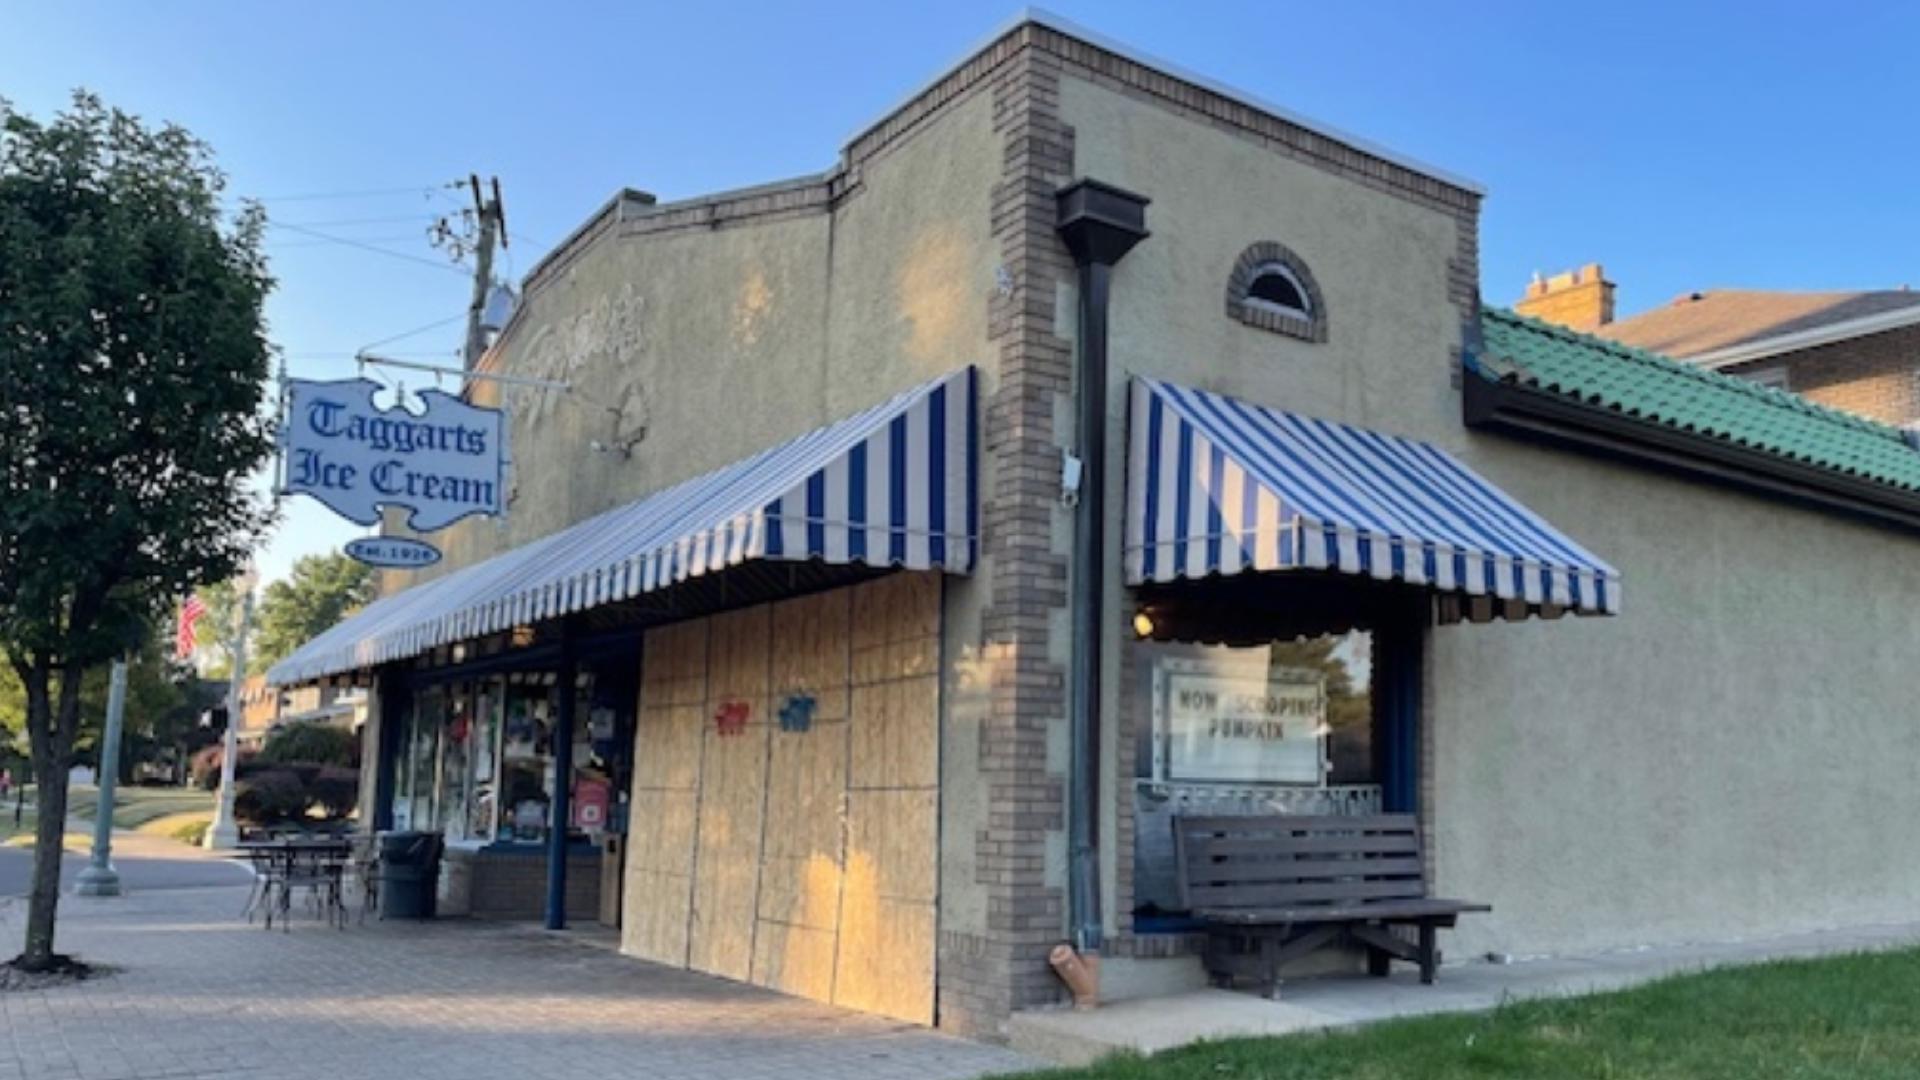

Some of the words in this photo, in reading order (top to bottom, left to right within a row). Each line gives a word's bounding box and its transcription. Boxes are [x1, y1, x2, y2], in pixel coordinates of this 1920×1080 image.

[307, 400, 487, 455] Taggarts
[294, 448, 356, 491] Ice
[370, 460, 493, 505] Cream
[1179, 690, 1217, 711] NOW
[1208, 717, 1284, 739] PUMPKIN
